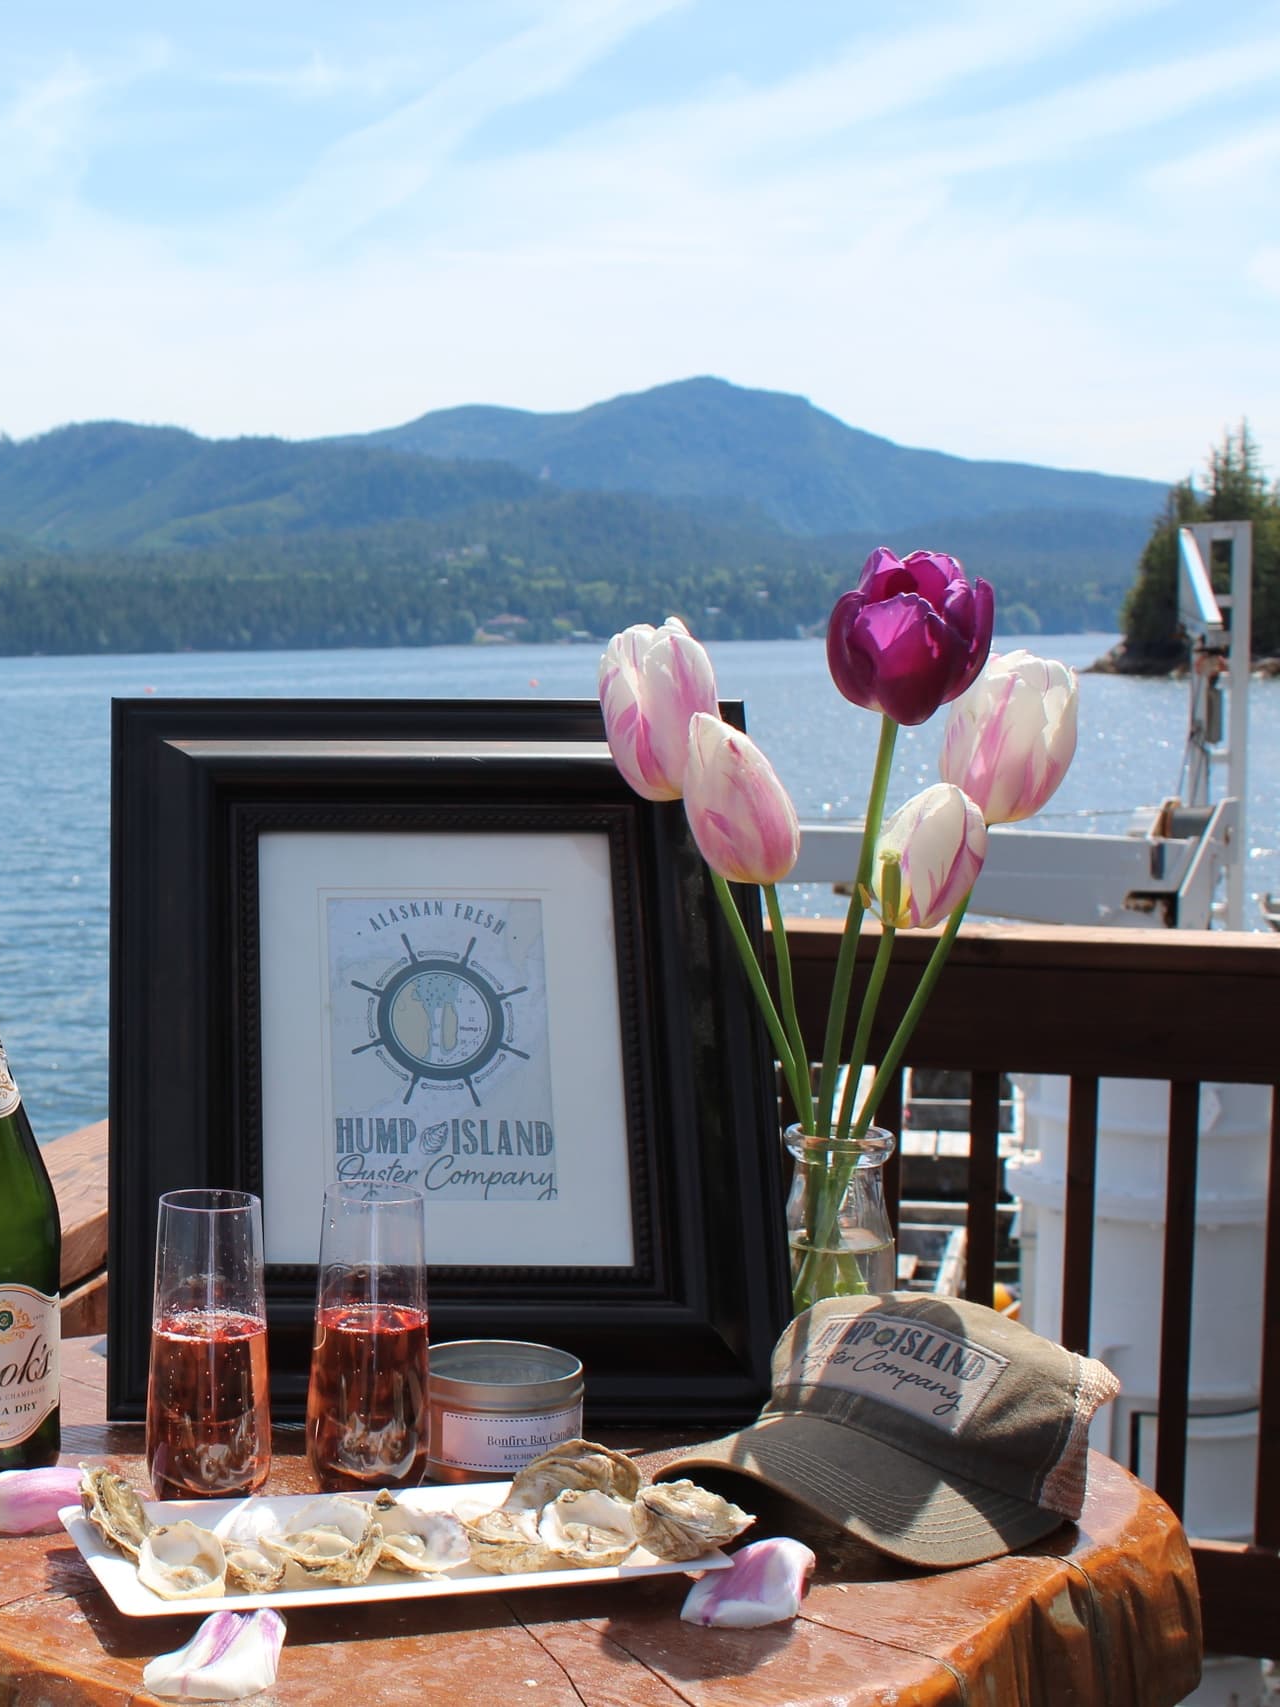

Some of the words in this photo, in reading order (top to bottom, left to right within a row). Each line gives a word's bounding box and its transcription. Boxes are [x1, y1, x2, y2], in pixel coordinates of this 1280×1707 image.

[369, 900, 444, 933] ALASKAN
[453, 902, 507, 936] FRESH
[335, 1117, 418, 1155] HUMP
[452, 1118, 554, 1157] ISLAND
[424, 1154, 559, 1201] Company
[890, 1327, 987, 1382] ISLAND
[852, 1350, 964, 1416] Company
[15, 1401, 38, 1414] DRY
[487, 1435, 528, 1446] Bonfire
[530, 1434, 547, 1445] Bay
